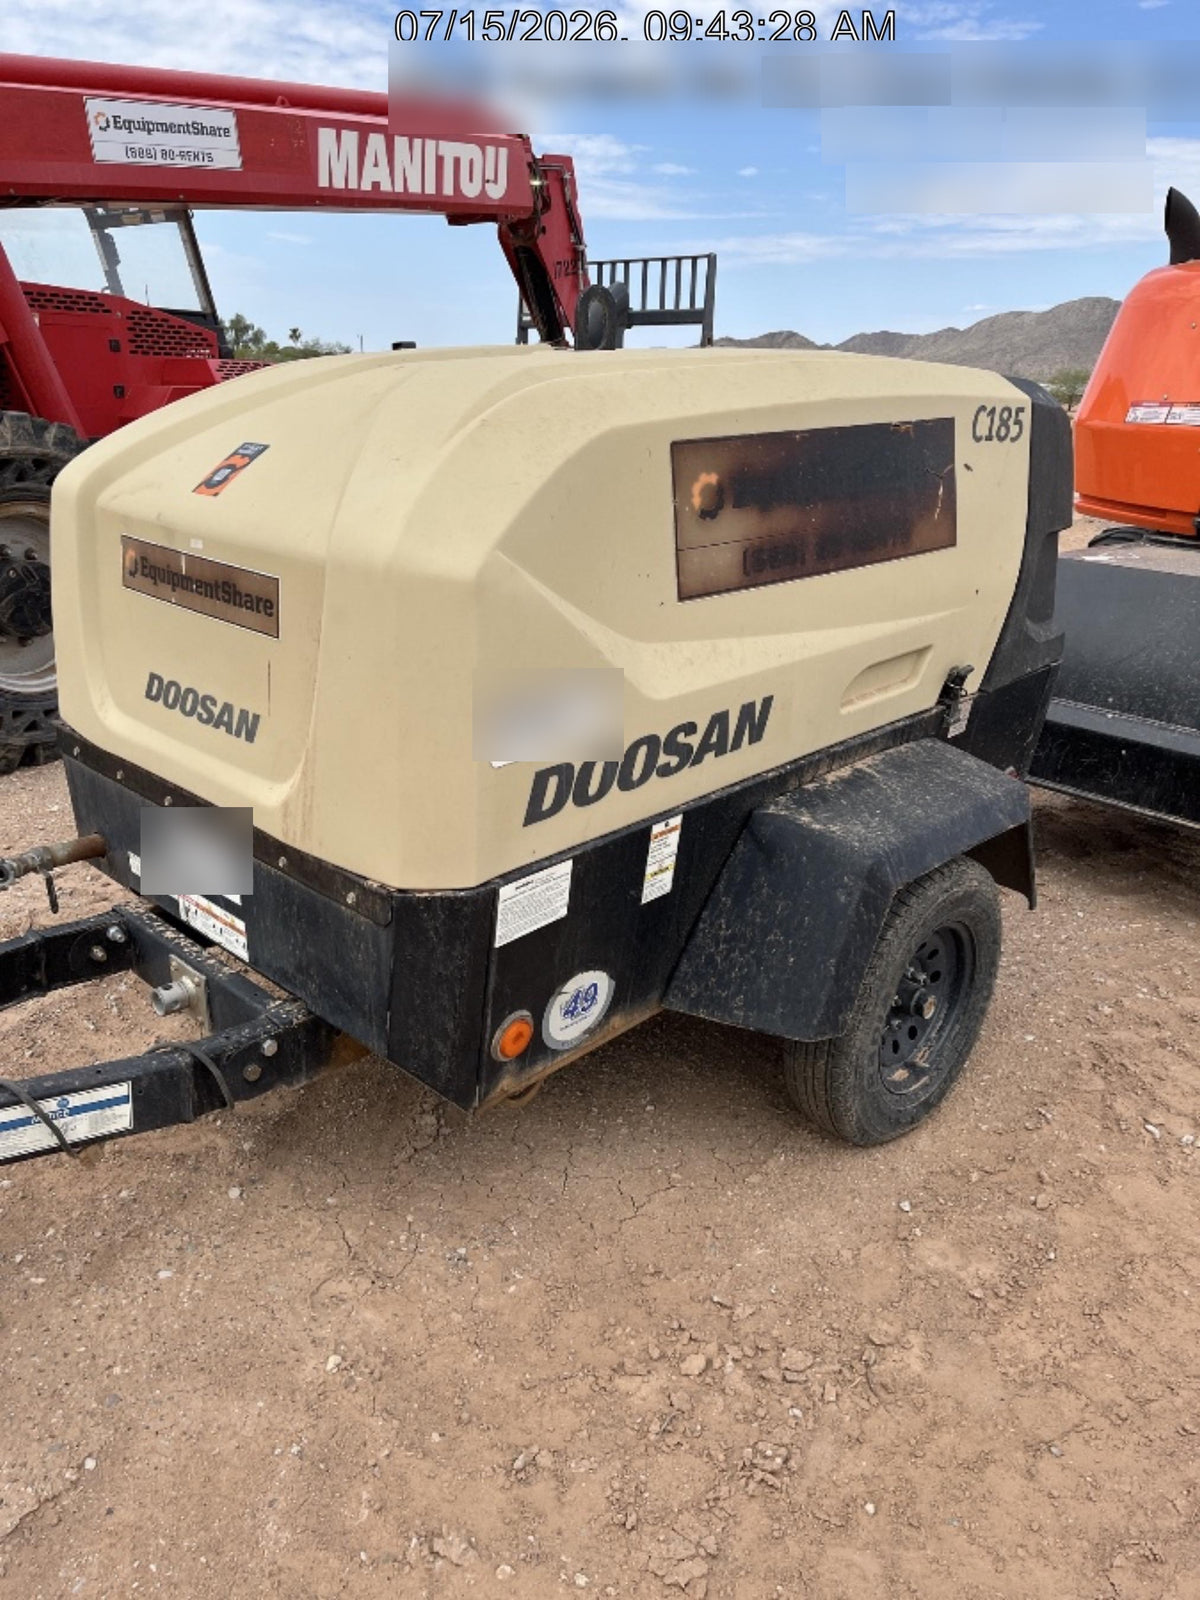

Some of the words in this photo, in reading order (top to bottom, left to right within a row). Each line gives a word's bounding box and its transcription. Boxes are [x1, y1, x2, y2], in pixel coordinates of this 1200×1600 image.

[111, 114, 231, 138] EquipmentShare
[317, 127, 509, 200] MANITOU
[972, 404, 1026, 443] C185
[139, 555, 275, 618] EquipmentShare
[145, 671, 261, 744] DOOSAN
[522, 694, 775, 828] DOOSAN
